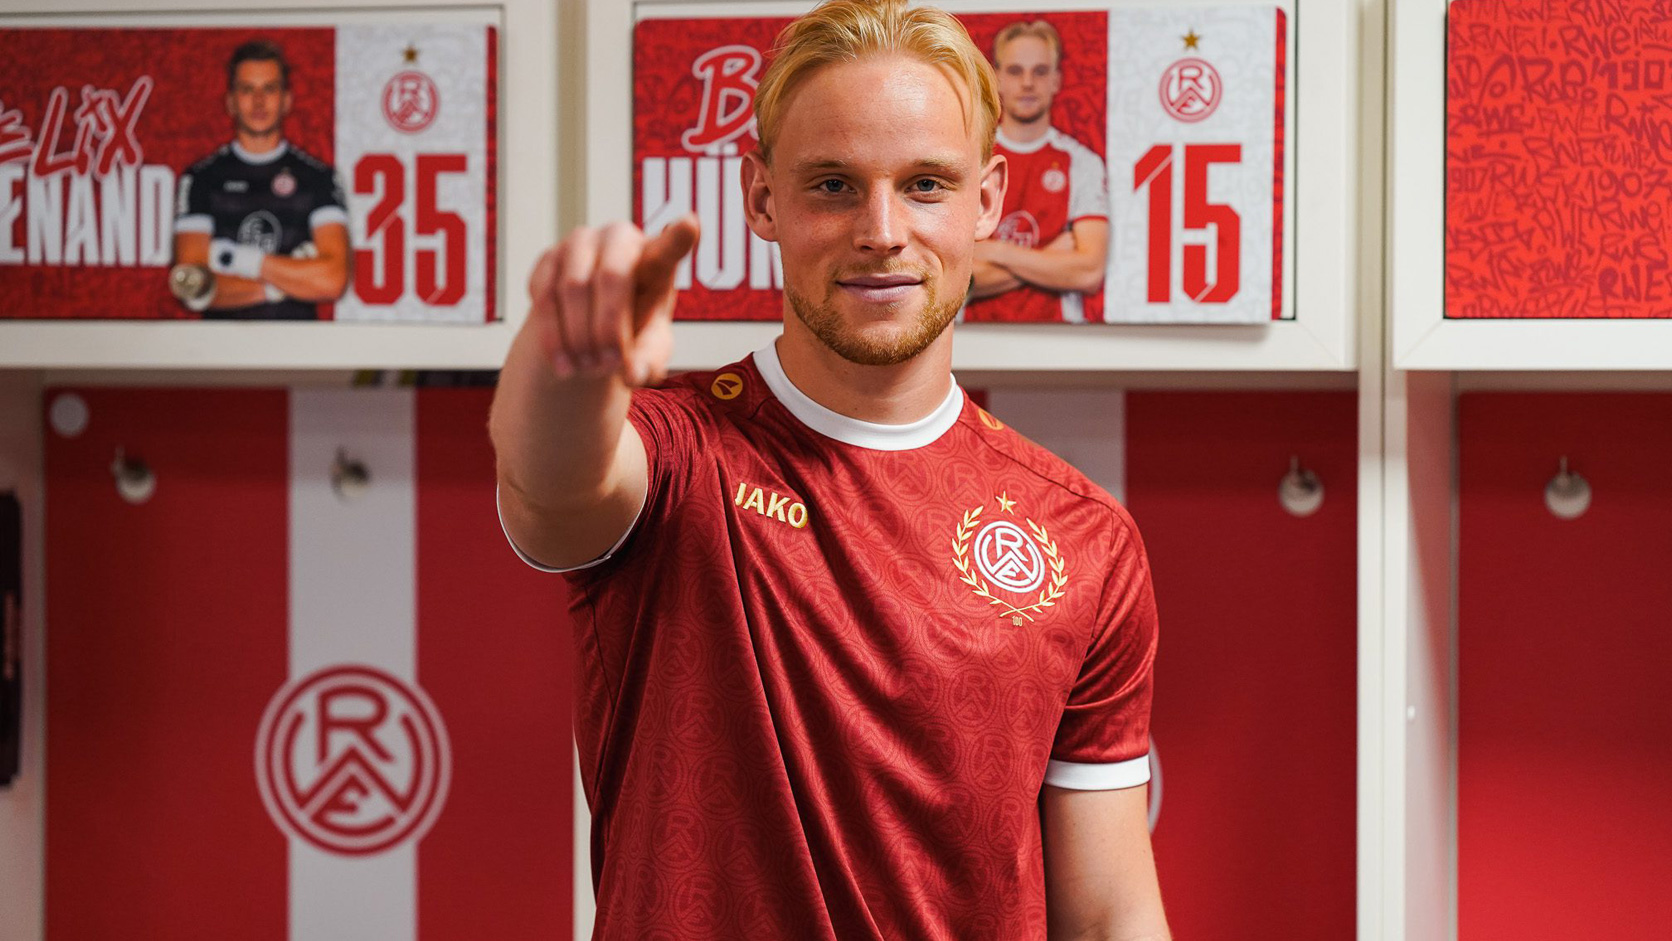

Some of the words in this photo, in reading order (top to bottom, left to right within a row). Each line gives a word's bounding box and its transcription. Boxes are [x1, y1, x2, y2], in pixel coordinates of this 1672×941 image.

[1598, 60, 1672, 91] 190
[352, 154, 467, 306] 35
[1134, 144, 1241, 303] 15
[734, 482, 809, 529] JAKO
